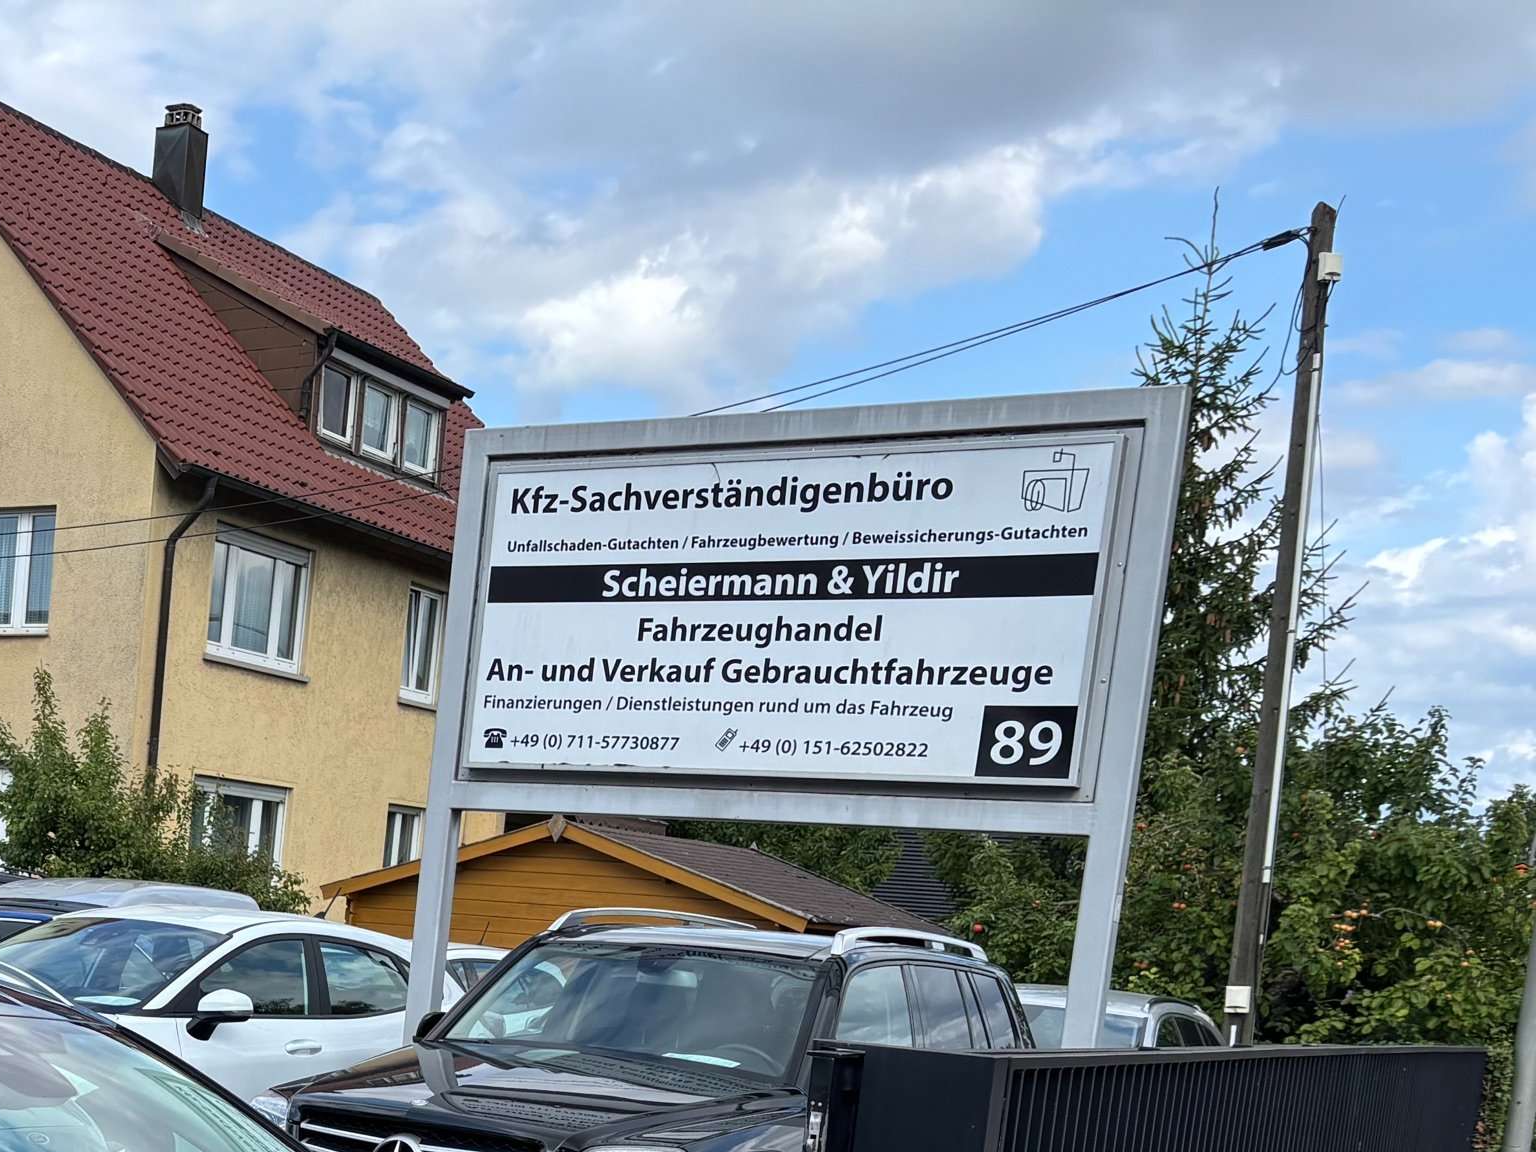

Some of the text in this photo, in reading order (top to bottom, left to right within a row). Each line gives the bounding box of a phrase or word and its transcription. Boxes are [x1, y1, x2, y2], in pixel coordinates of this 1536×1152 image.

[511, 471, 954, 514] Kfz-Sachverständigenbüro
[507, 524, 1088, 553] Unfallschaden-Gutachten / Fahrzeugbewertung / Beweissicherungs-Gutachten
[602, 562, 960, 598] Scheiermann & Yildir
[637, 615, 883, 648] Fahrzeughandel
[486, 657, 1053, 692] An- und Verkauf Gebrauchtfahrzeuge
[483, 694, 953, 722] Finanzierungen / Dienstleistungen rund um das Fahrzeug
[510, 733, 680, 750] +49 (0) 711-57730877
[739, 738, 928, 758] +49 (0) 151-62502822
[989, 720, 1064, 766] 89
